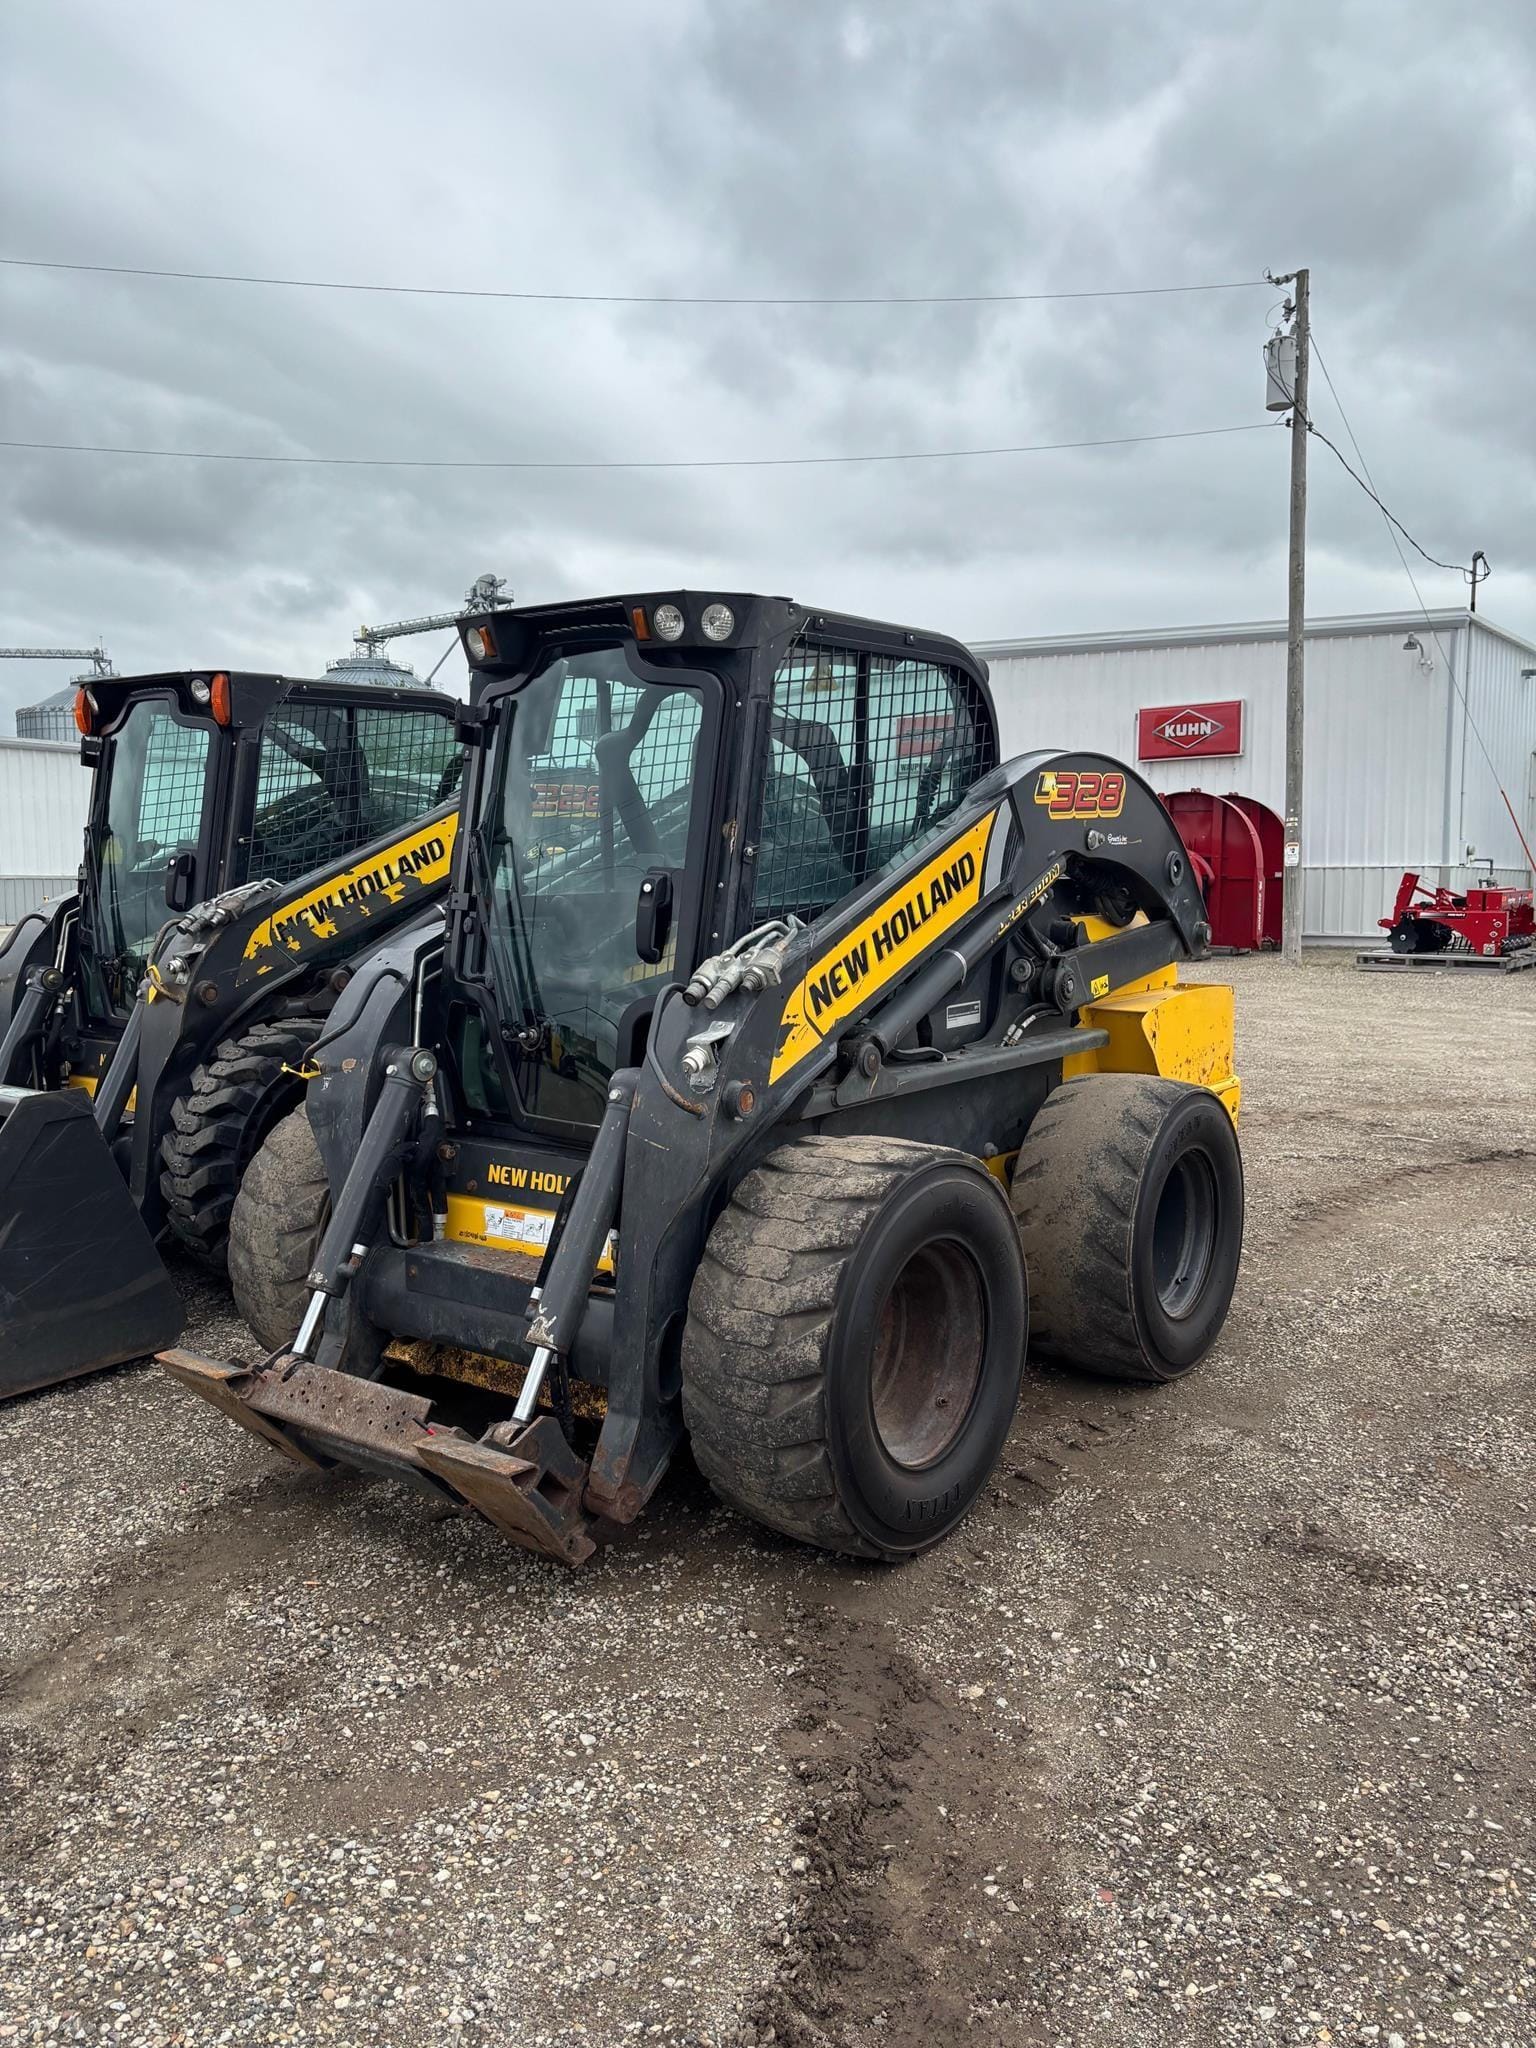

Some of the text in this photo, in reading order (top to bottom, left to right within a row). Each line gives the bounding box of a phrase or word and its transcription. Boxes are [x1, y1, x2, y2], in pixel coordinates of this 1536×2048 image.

[1164, 721, 1212, 738] KUHN
[1034, 772, 1127, 820] L328
[339, 837, 445, 906] HOLLAND
[808, 852, 975, 1017] NEW HOLLAND
[488, 1164, 527, 1187] NEW
